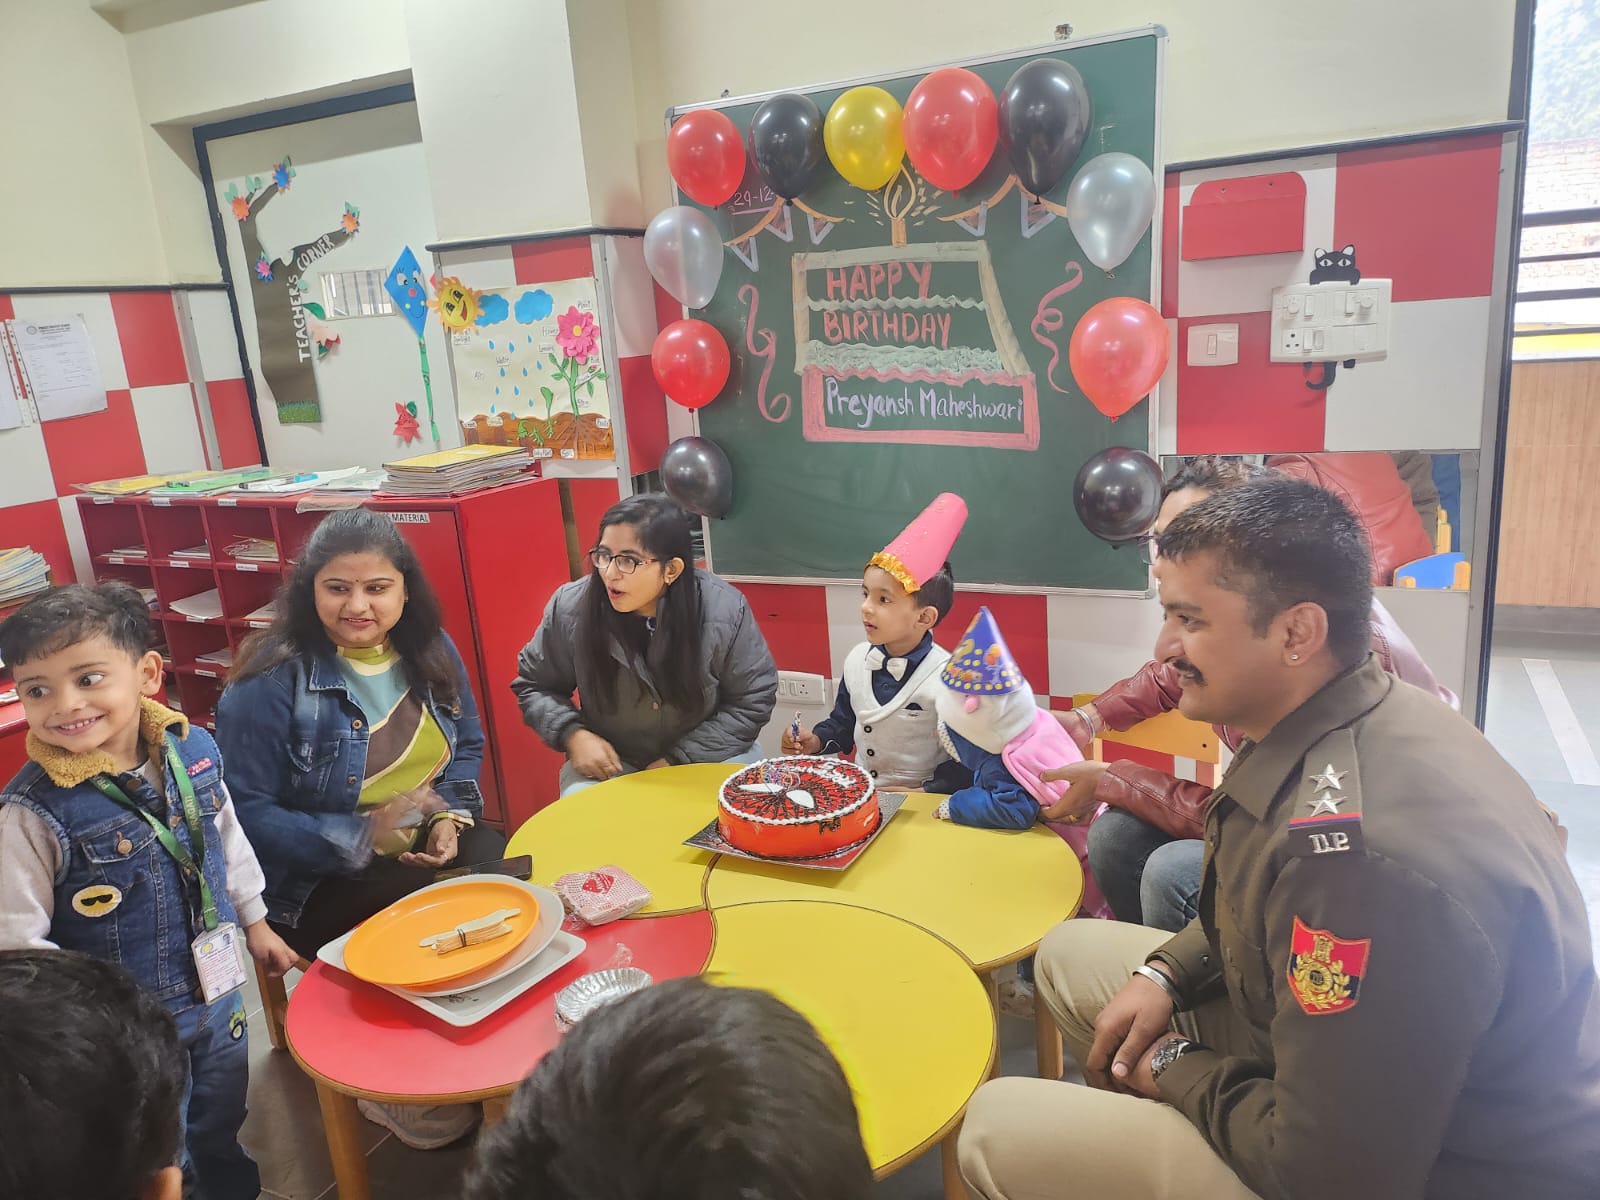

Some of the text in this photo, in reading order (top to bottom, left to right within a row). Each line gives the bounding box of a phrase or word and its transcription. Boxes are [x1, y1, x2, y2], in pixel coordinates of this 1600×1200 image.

[287, 235, 334, 362] TEACHER'S CORNER
[826, 262, 932, 300] HAPPY
[823, 310, 951, 349] BIRTHDAY
[826, 378, 1023, 428] Preyansh Maheshwari
[391, 513, 429, 523] MATERIAL
